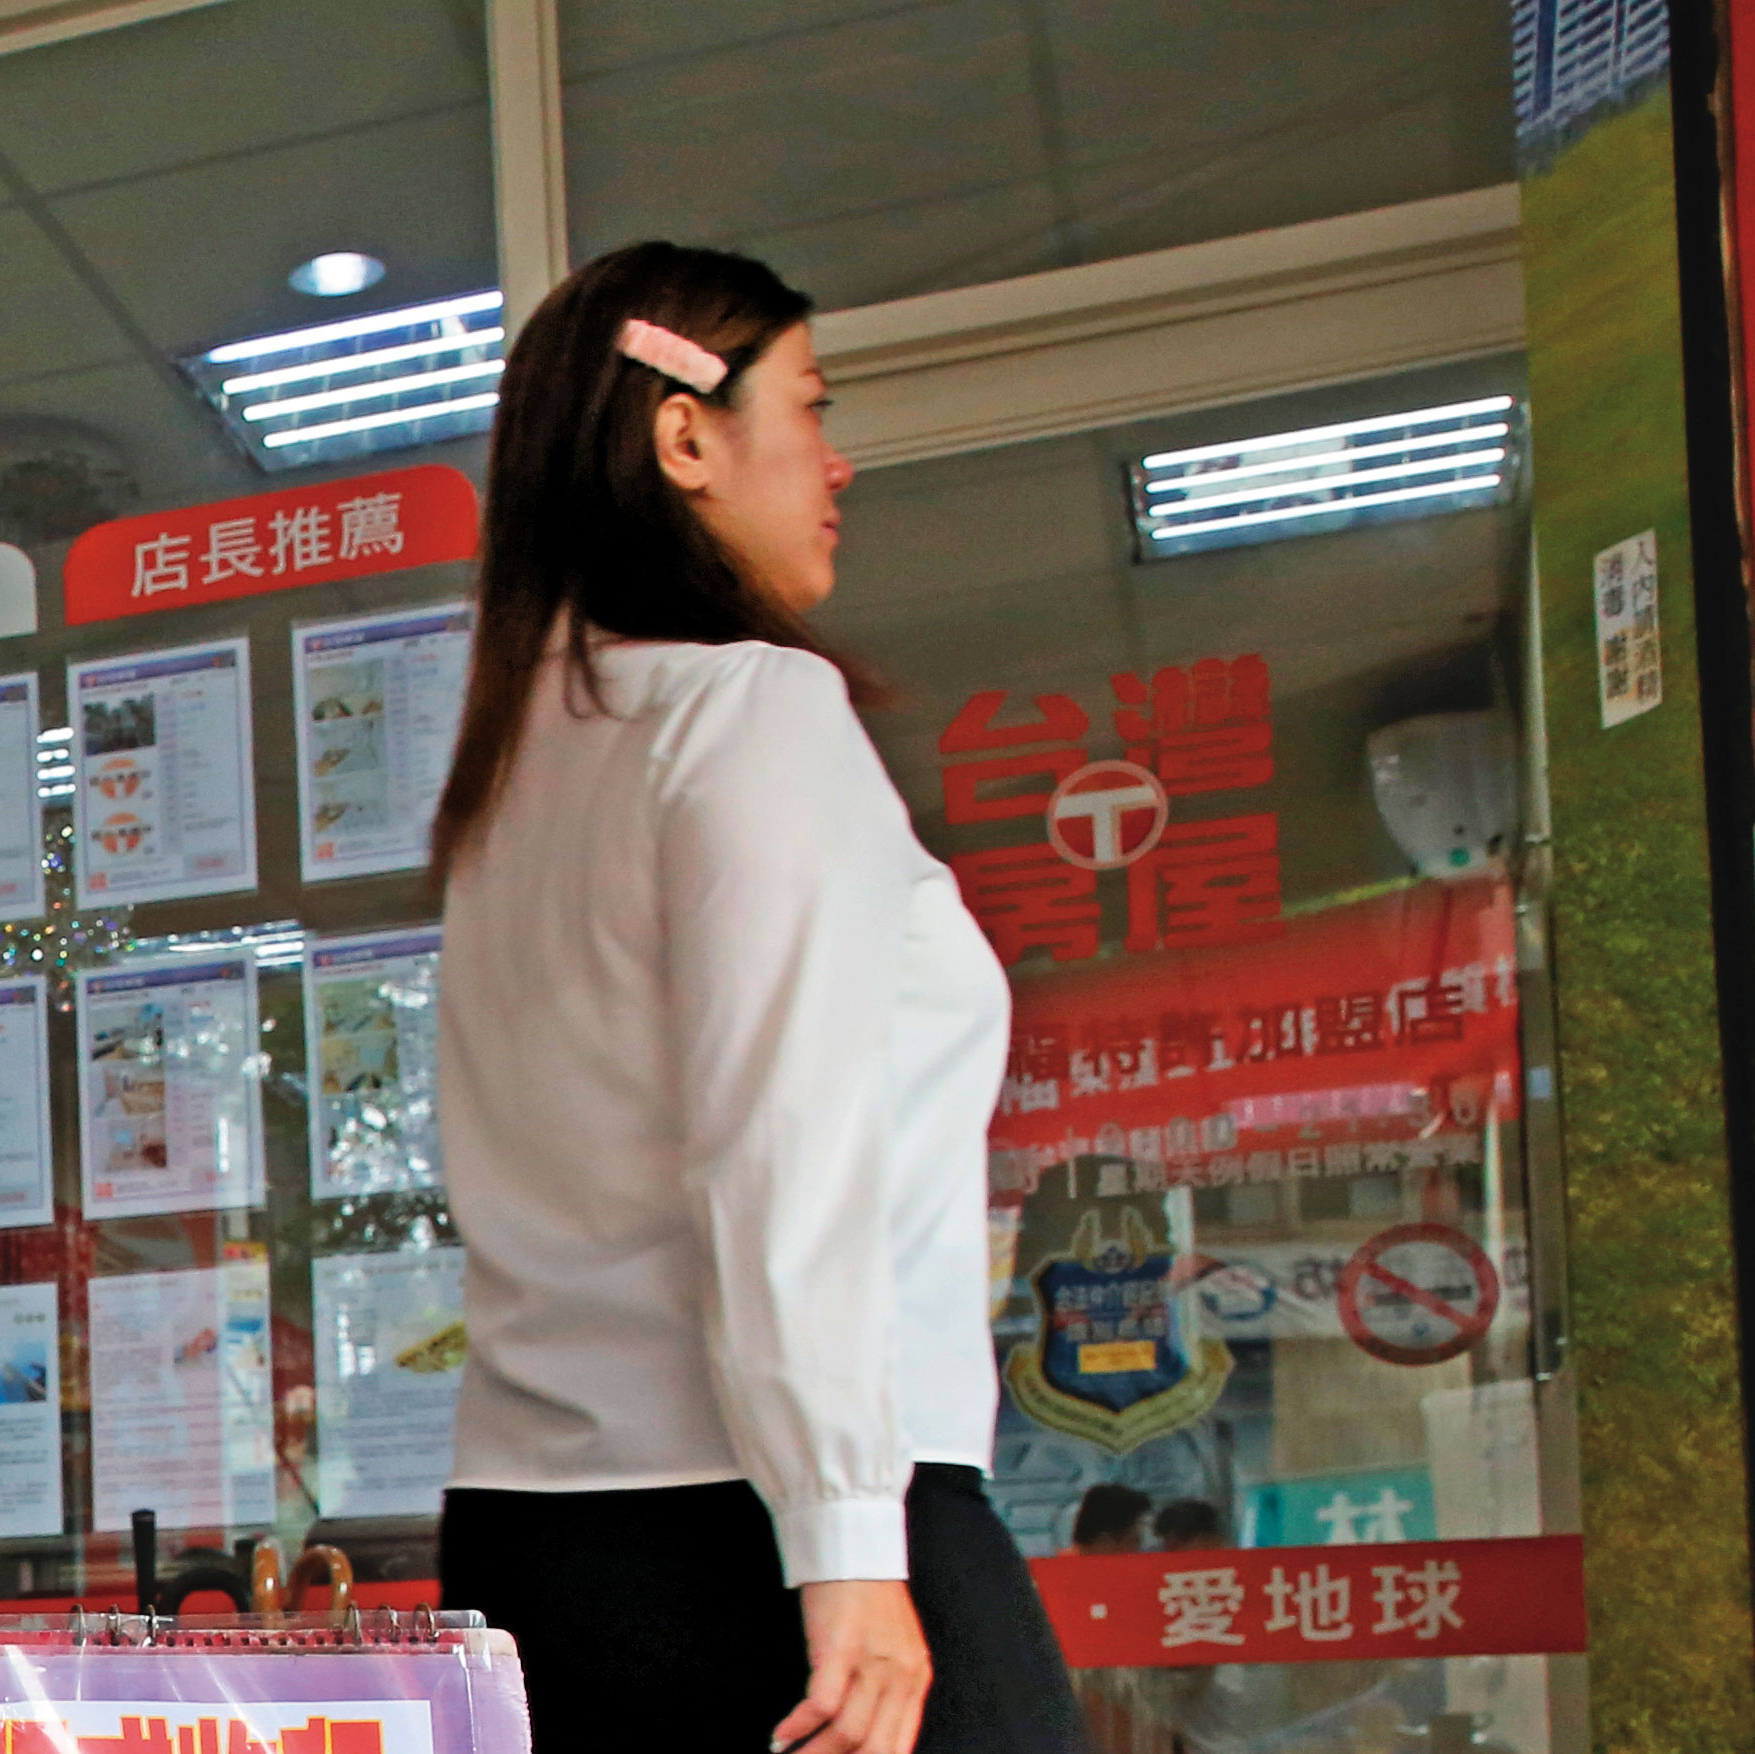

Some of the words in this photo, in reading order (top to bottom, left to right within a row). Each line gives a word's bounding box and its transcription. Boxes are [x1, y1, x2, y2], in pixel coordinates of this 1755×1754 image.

[131, 490, 406, 600] 店長推薦
[1157, 1560, 1465, 1648] 愛地球
